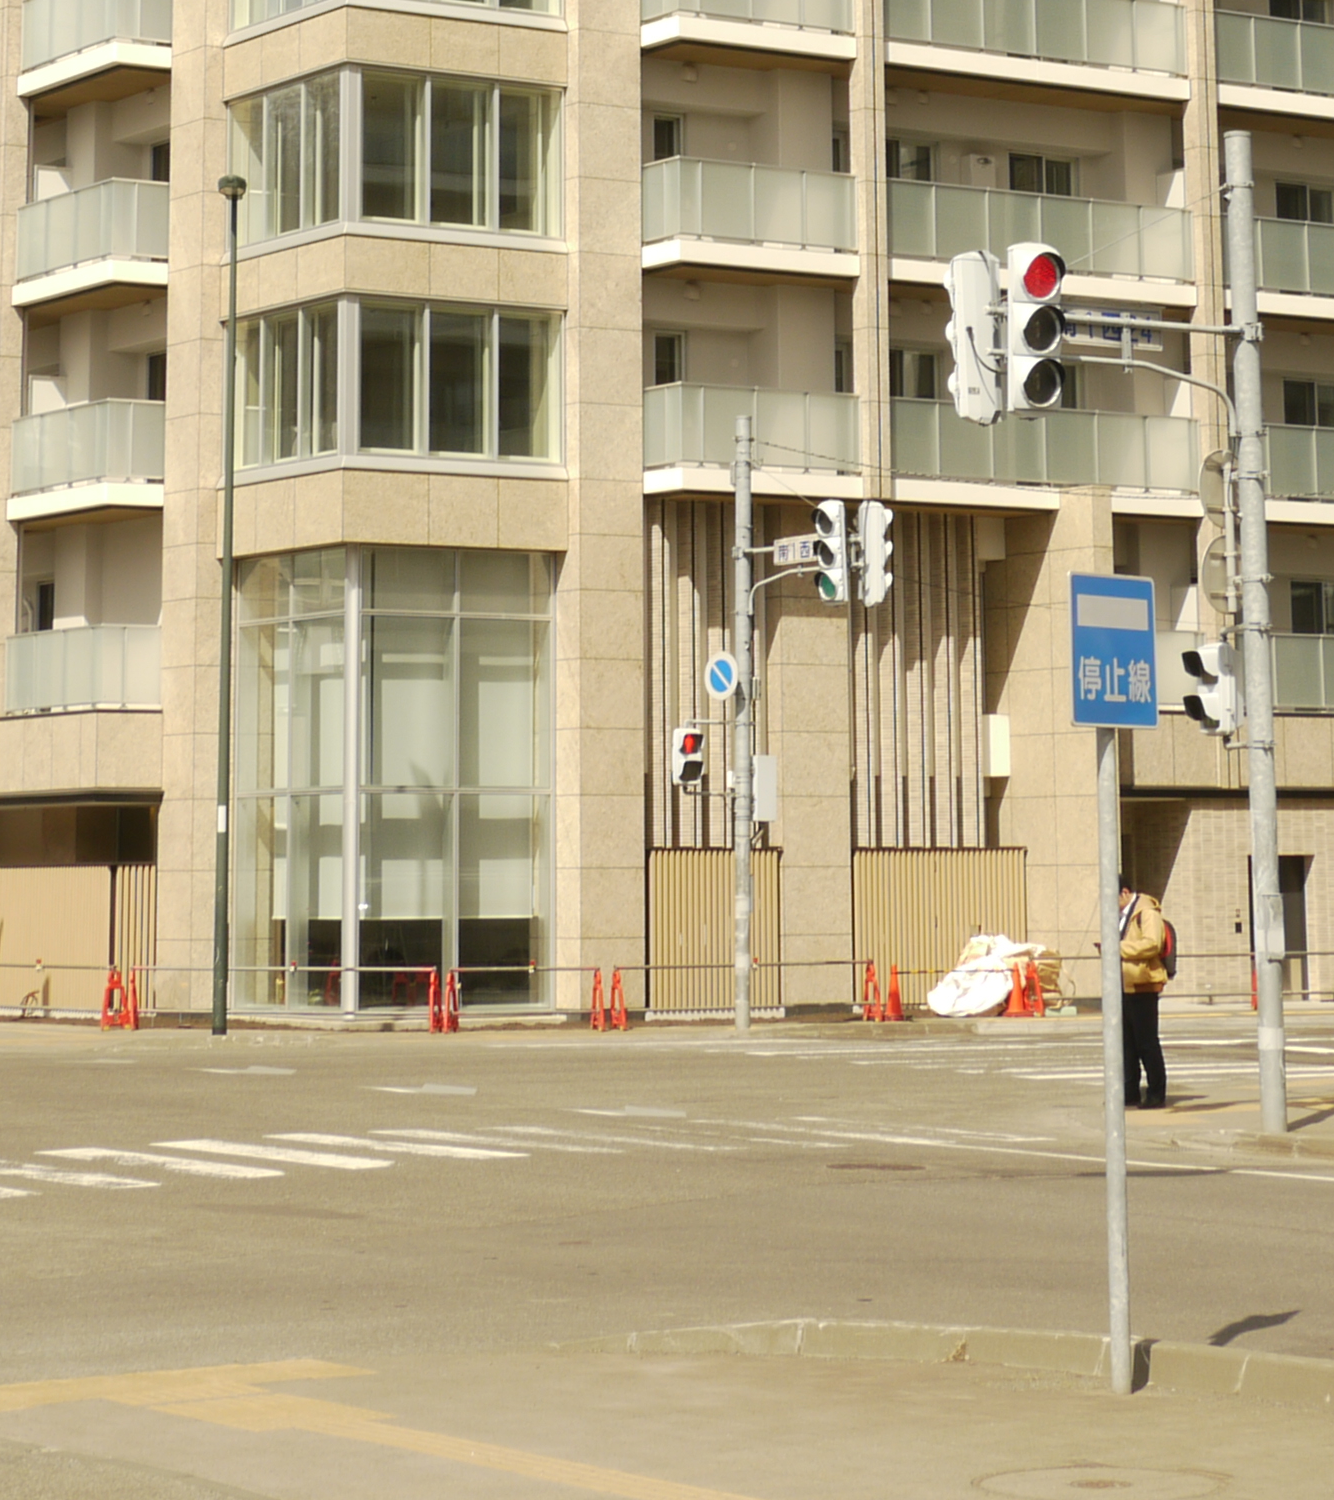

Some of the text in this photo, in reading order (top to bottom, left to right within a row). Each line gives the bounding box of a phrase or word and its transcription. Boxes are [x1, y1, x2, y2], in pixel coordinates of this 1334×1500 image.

[779, 541, 811, 563] 南1西
[1078, 655, 1151, 703] 停止線
